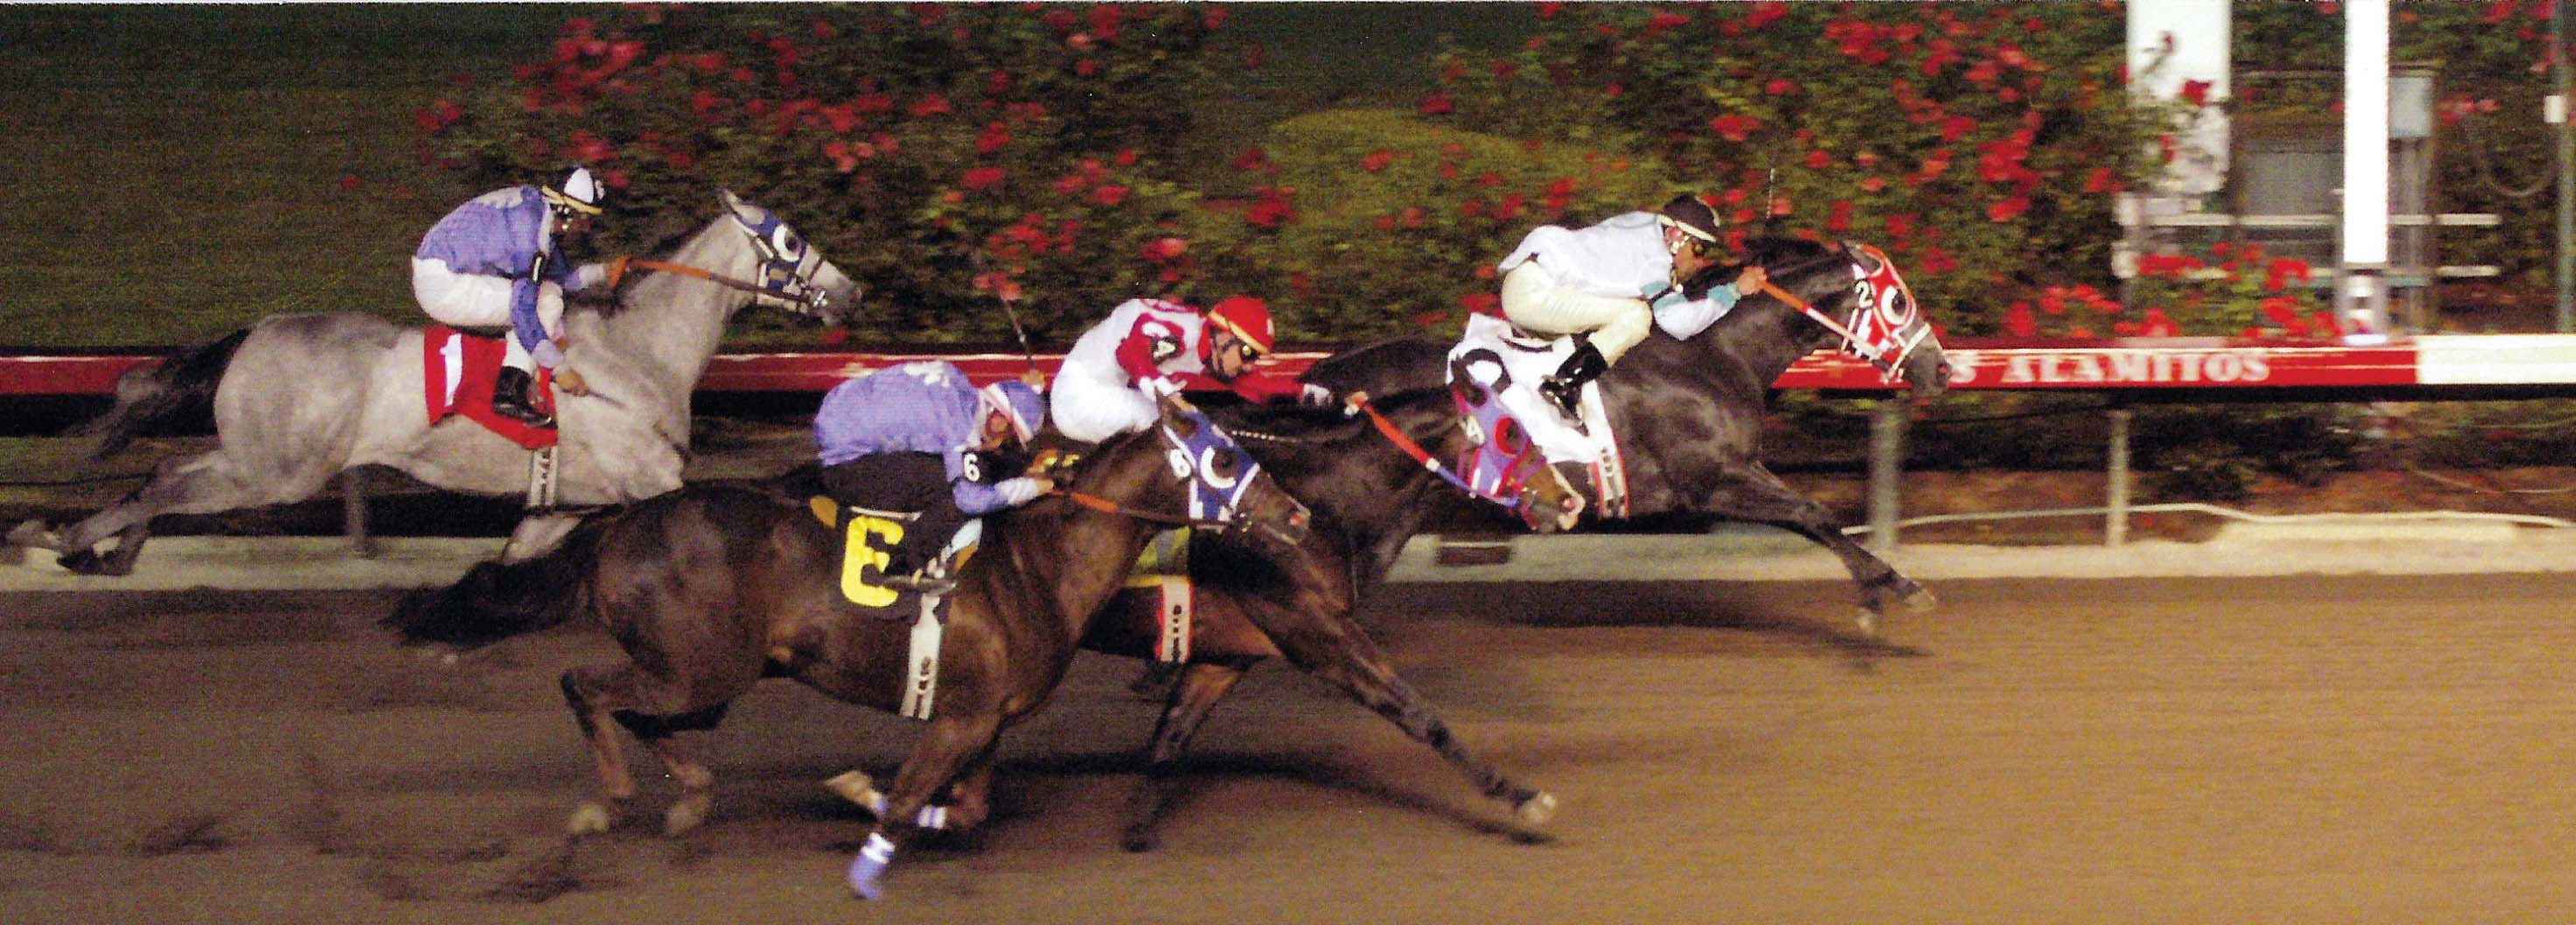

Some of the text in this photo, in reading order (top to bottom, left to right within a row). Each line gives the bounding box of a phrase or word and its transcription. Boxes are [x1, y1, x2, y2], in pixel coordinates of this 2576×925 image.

[1855, 279, 1874, 308] 2
[440, 333, 463, 406] 1
[2001, 353, 2270, 383] ALAMITOS
[963, 453, 980, 482] 6
[1170, 448, 1192, 478] 6
